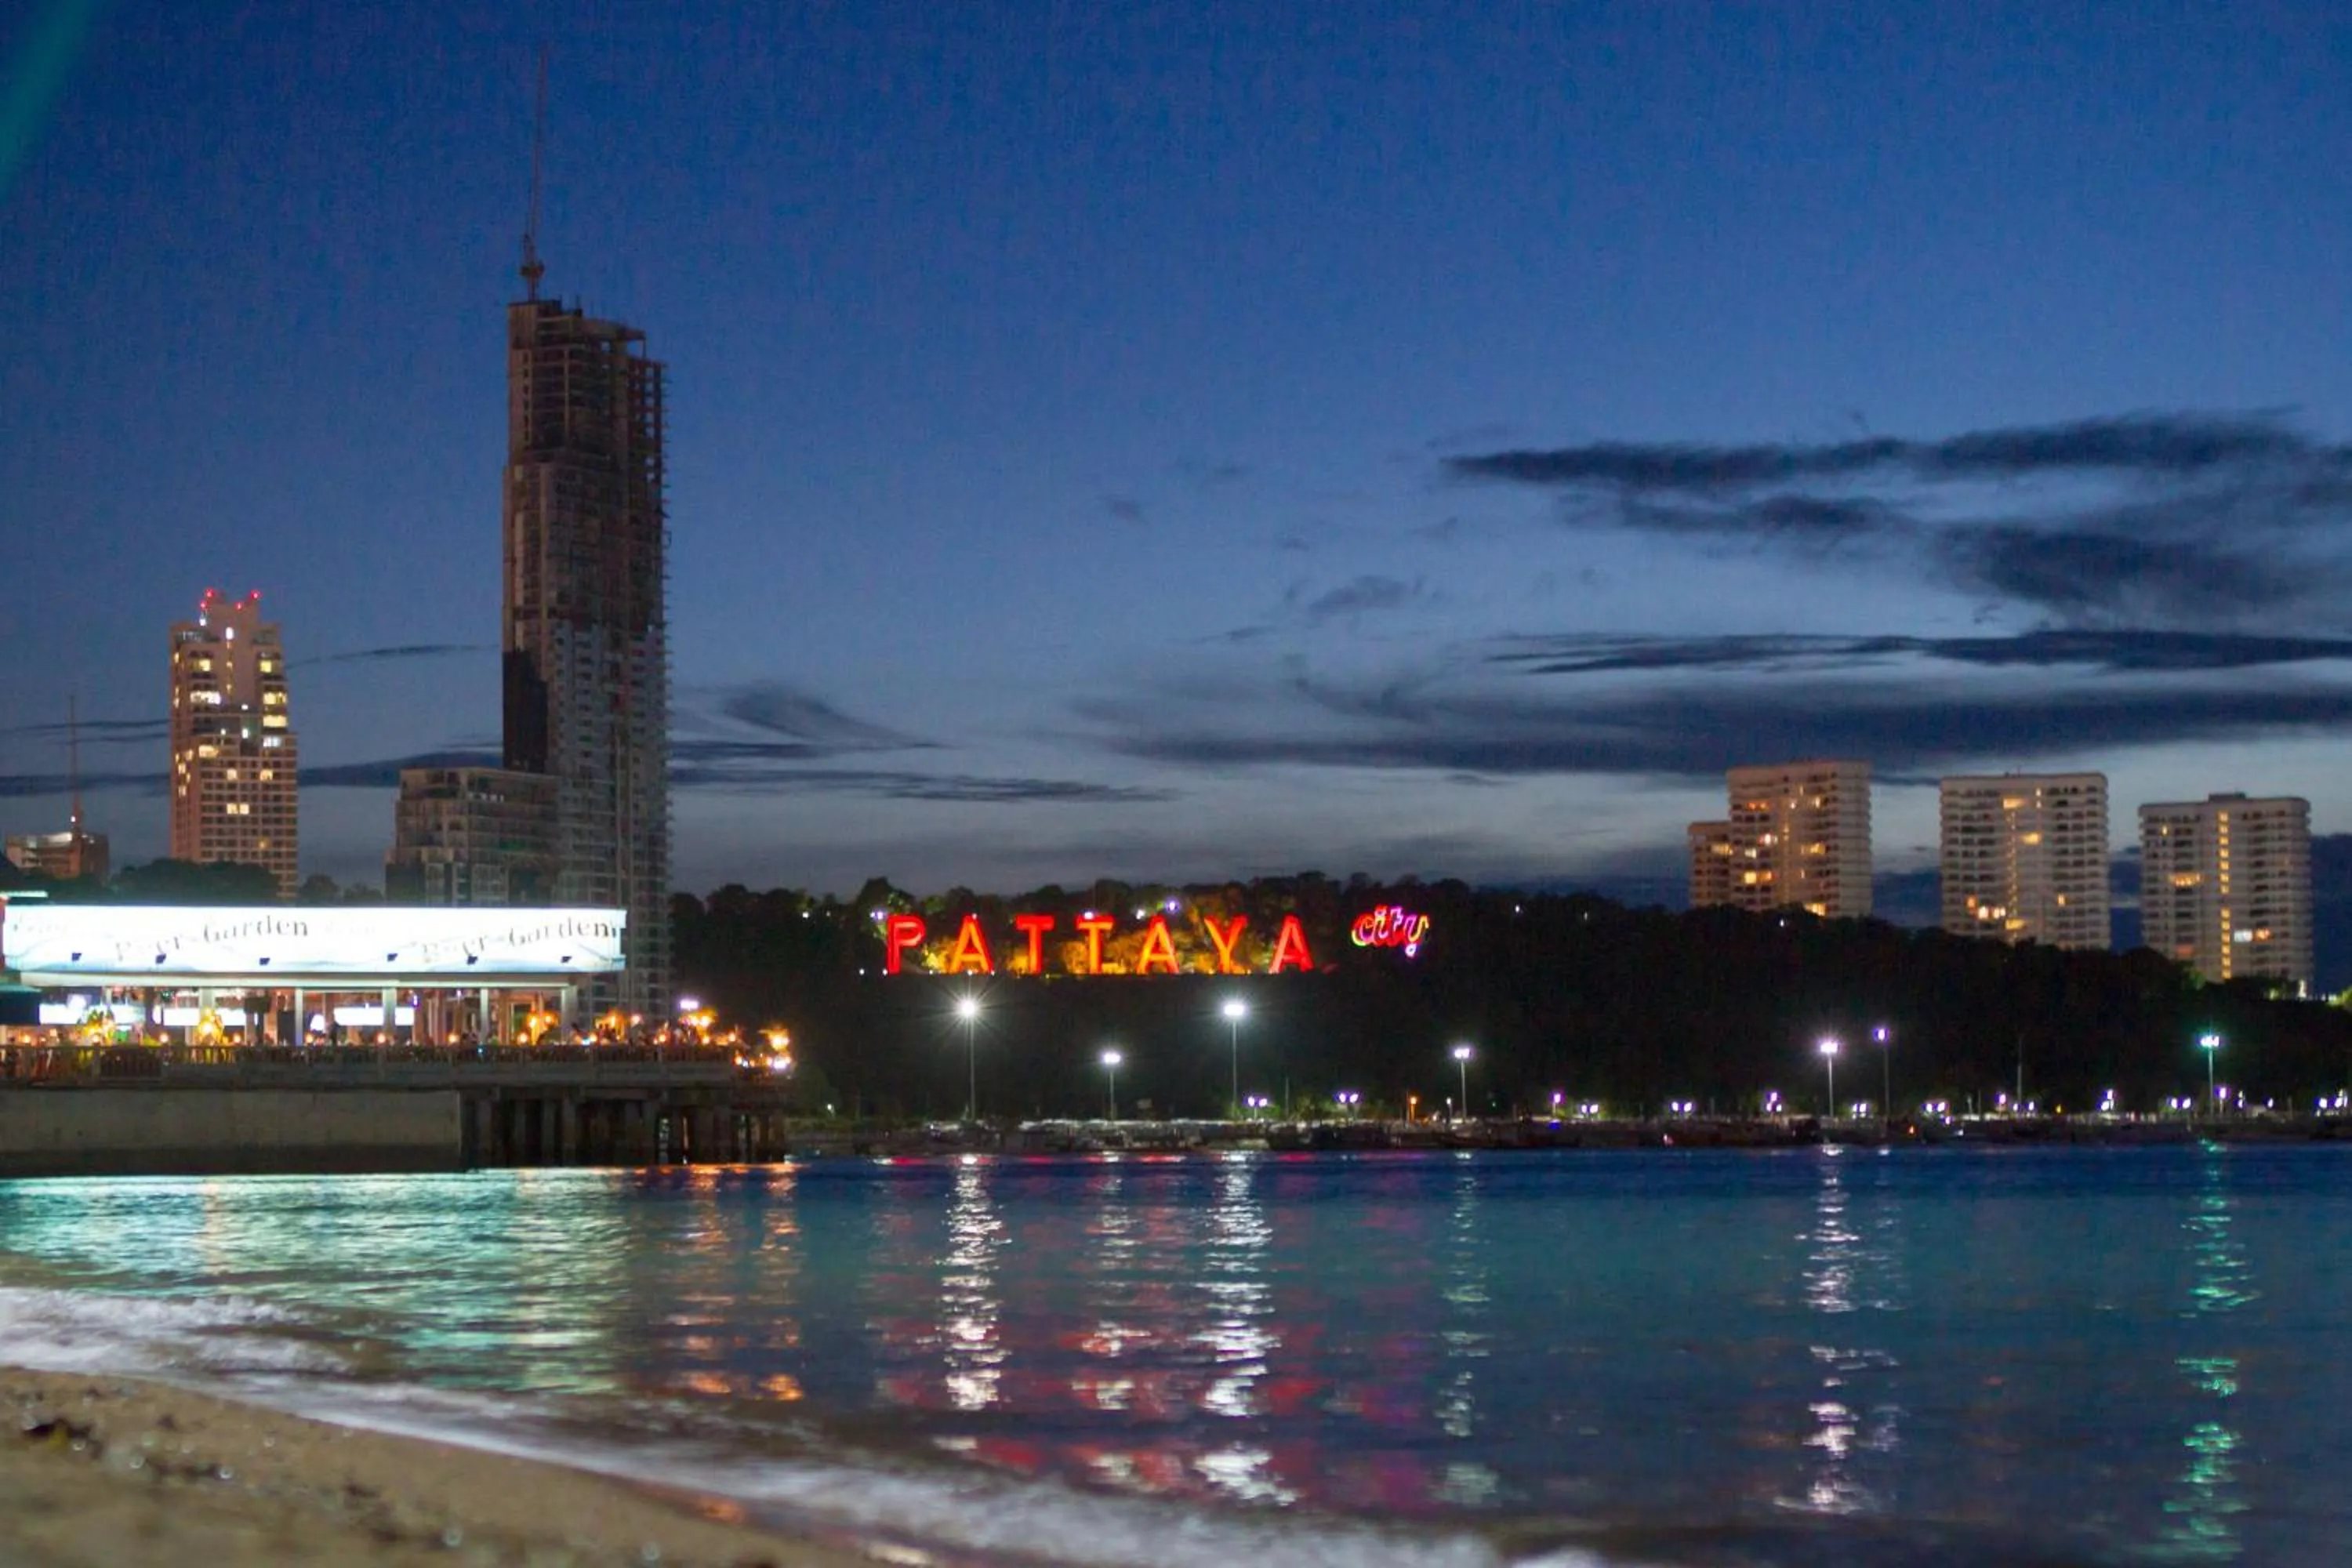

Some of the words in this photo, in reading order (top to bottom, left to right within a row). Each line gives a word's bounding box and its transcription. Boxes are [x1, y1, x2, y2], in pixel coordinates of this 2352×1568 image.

[202, 914, 309, 944] Garden
[509, 916, 610, 947] Garden
[886, 914, 1315, 975] PATTAYA
